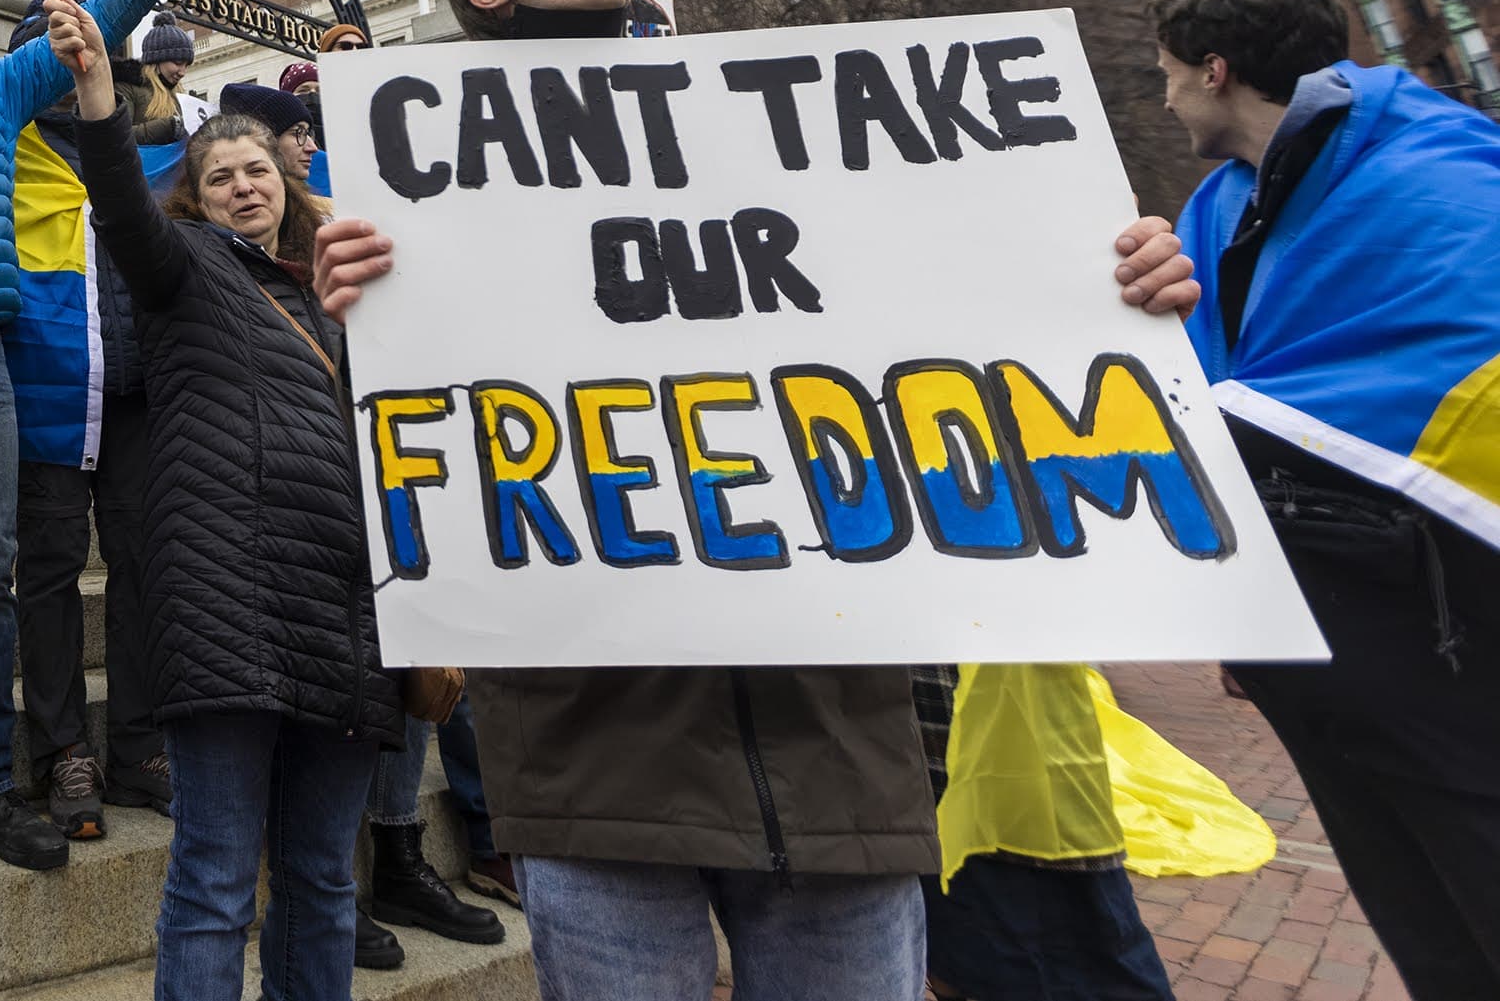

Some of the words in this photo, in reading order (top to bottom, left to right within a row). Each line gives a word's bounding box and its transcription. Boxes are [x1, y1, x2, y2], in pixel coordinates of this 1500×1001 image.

[283, 15, 324, 49] HOU
[369, 59, 691, 202] CANT
[721, 35, 1077, 171] TAKE
[591, 207, 823, 324] OUR
[360, 353, 1237, 585] FREEDOM
